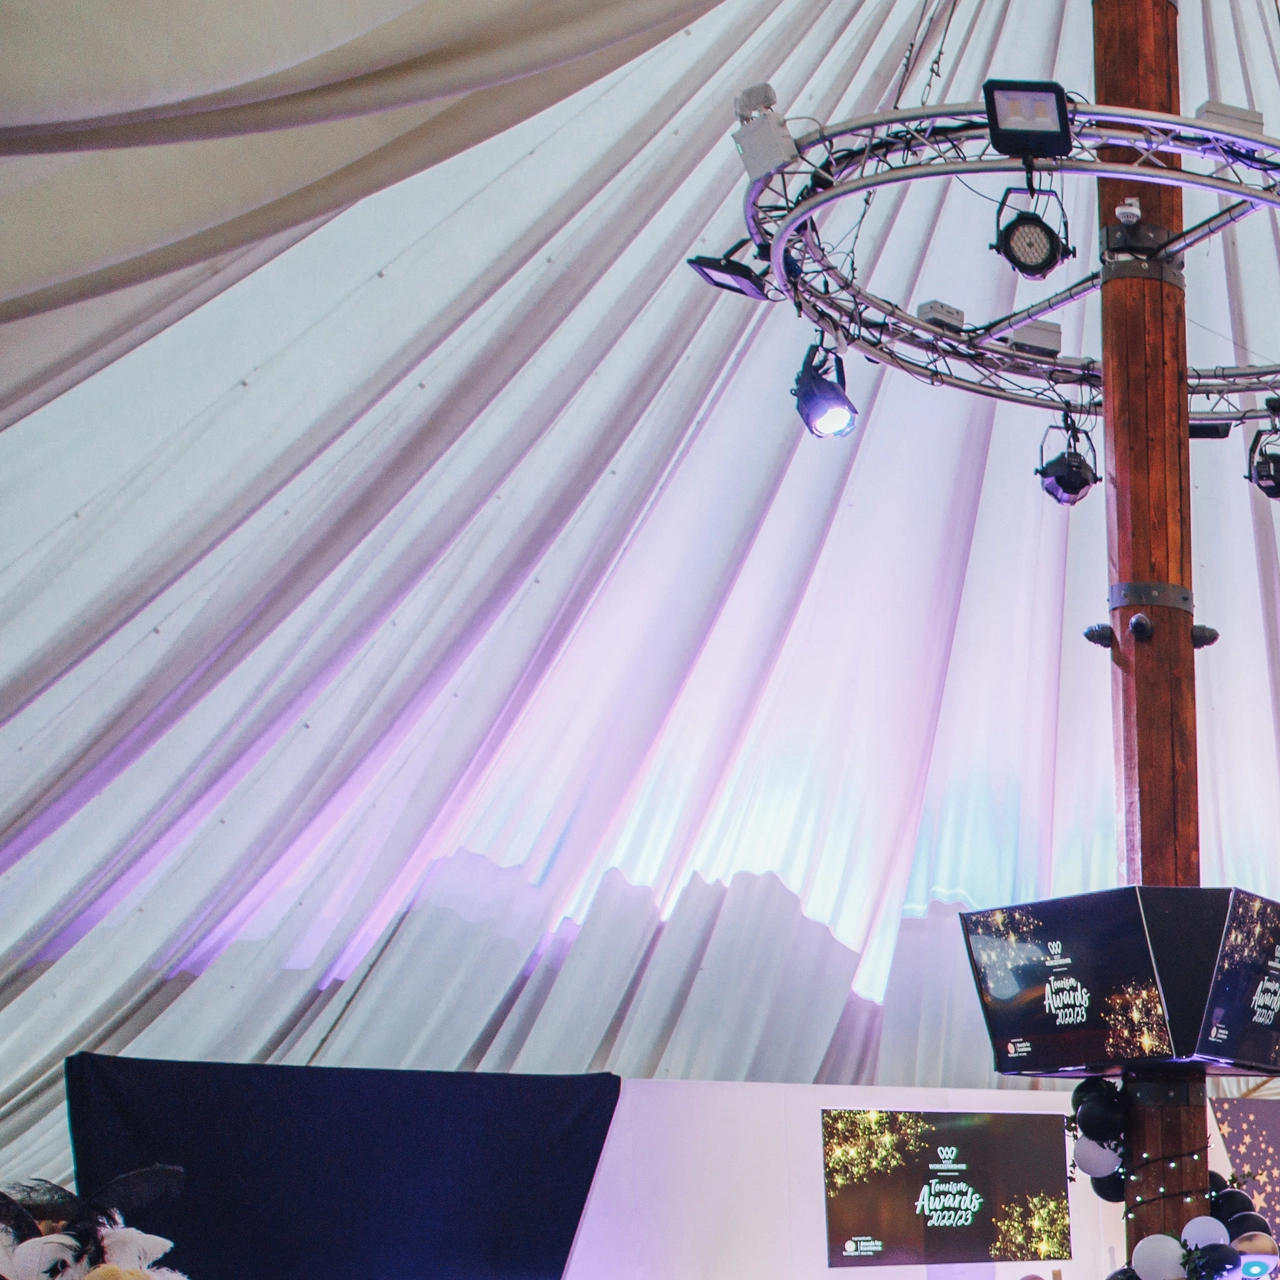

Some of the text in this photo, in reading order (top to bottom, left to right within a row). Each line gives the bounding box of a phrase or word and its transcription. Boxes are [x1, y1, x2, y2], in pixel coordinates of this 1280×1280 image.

[1048, 976, 1077, 992] Tourism
[1043, 983, 1090, 1014] Awards
[1056, 1006, 1087, 1026] 2022/23
[929, 1178, 969, 1195] Tourism
[914, 1184, 984, 1216] Awards
[927, 1210, 973, 1228] 2022/23
